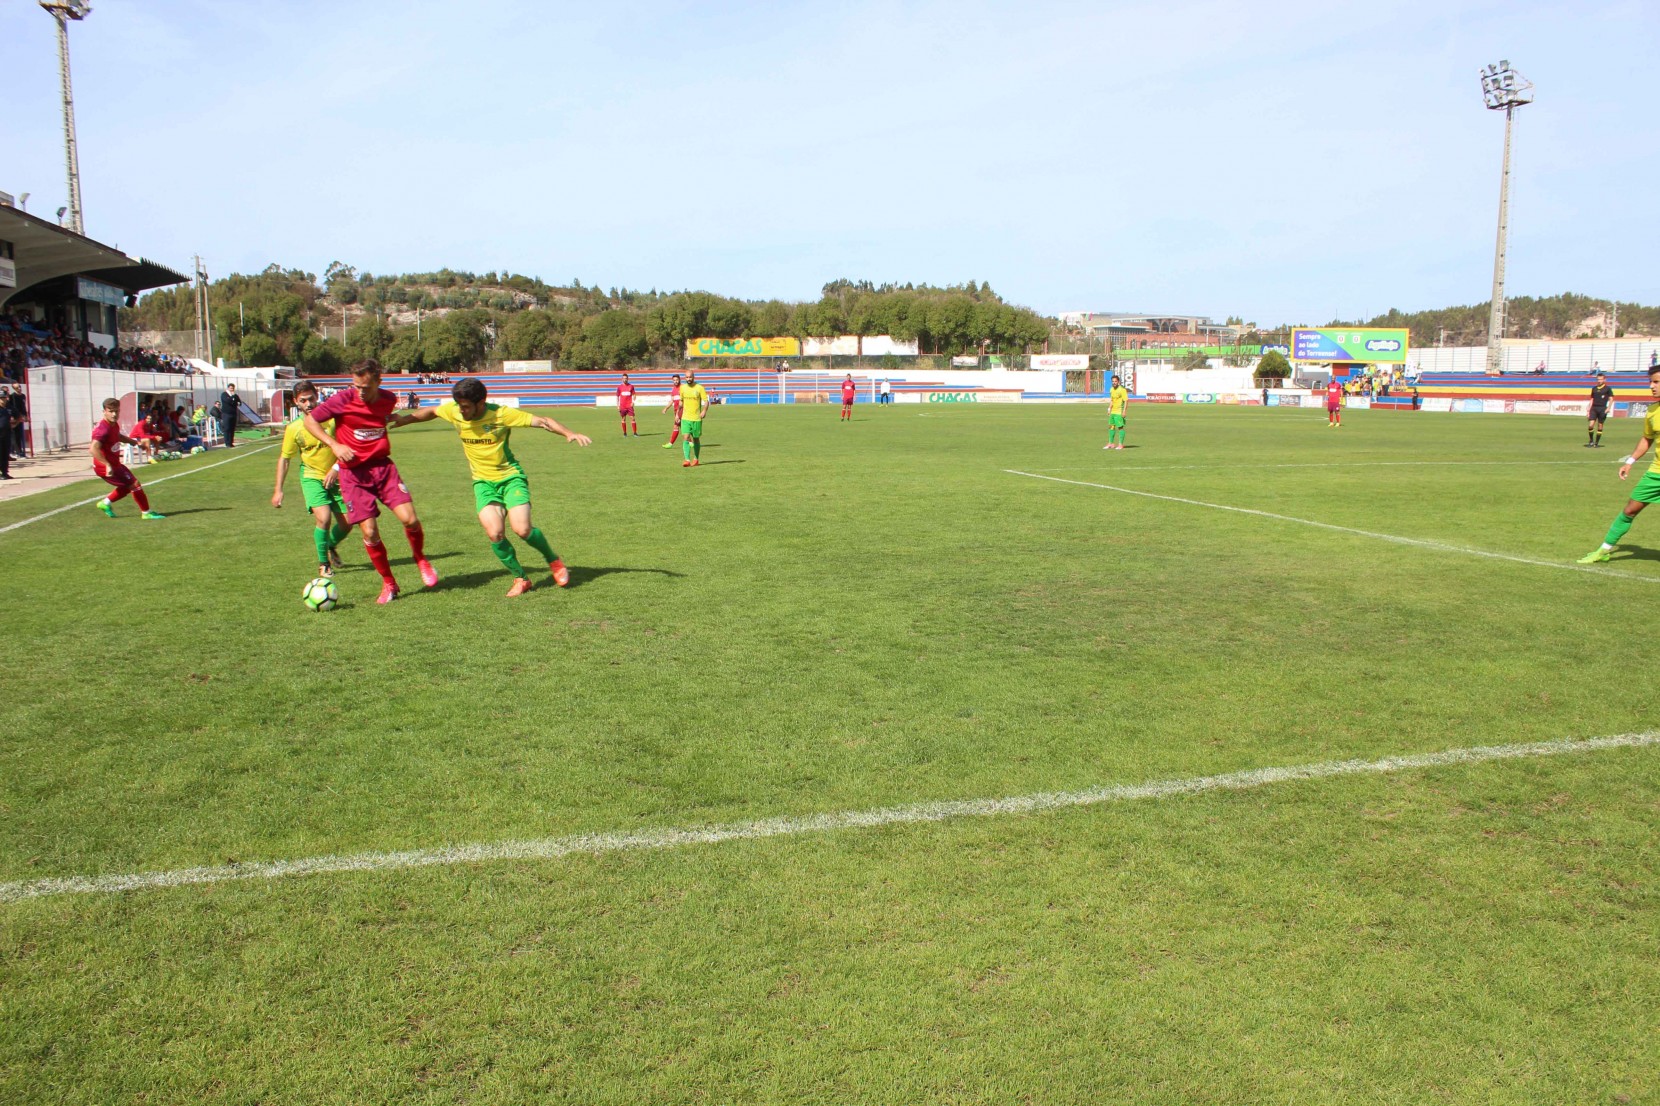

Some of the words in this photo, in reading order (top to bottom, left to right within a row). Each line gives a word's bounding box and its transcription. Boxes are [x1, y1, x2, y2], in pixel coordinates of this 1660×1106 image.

[1298, 333, 1321, 341] Sempre
[698, 338, 762, 354] CHAGAS
[928, 392, 977, 403] CHAGAS
